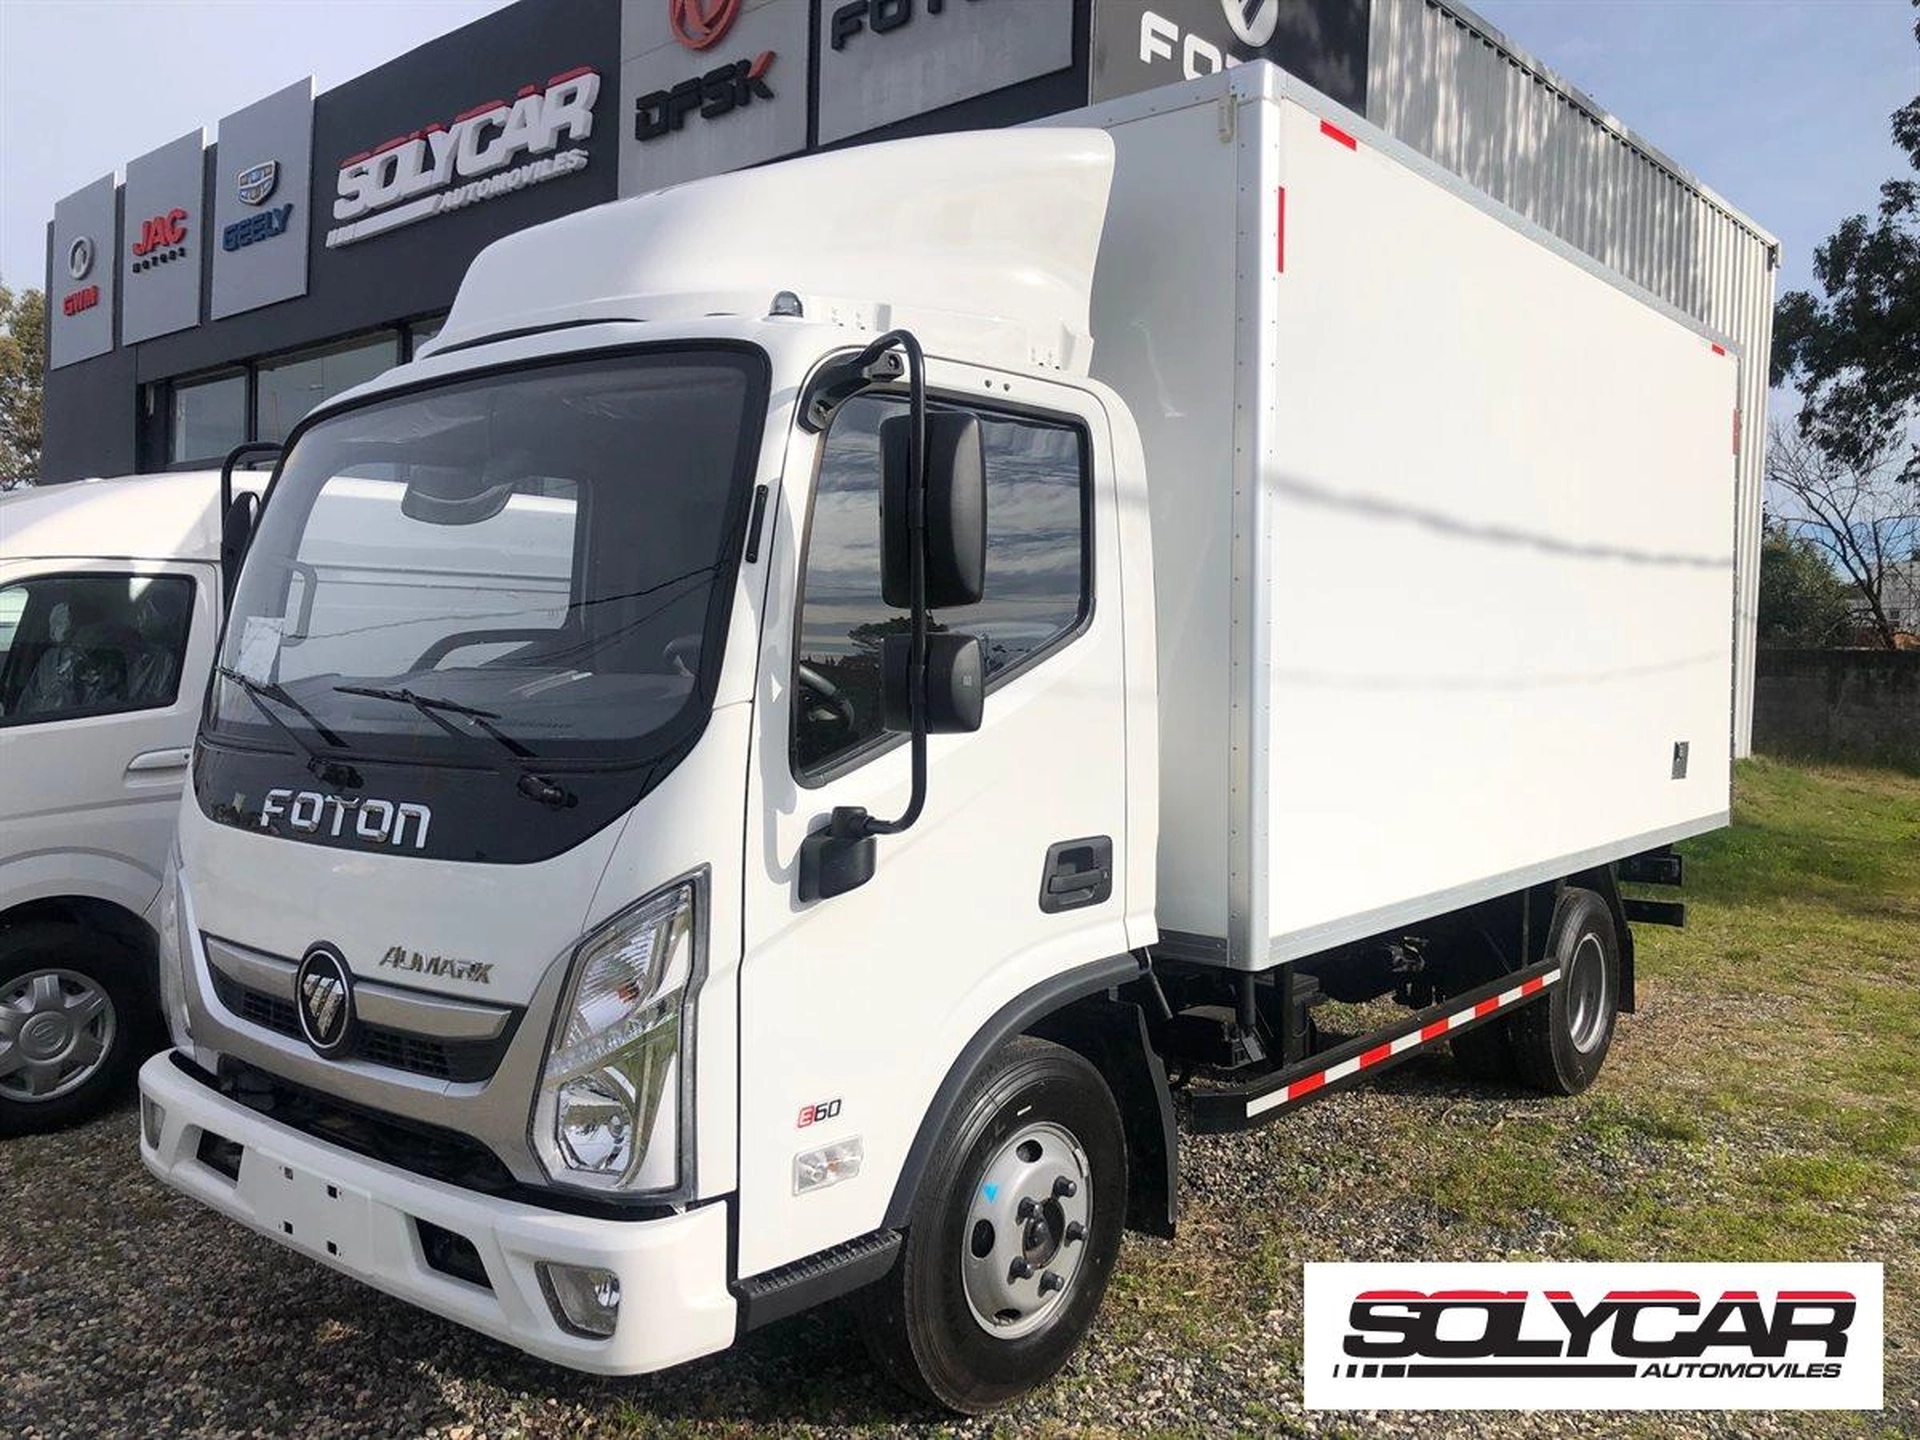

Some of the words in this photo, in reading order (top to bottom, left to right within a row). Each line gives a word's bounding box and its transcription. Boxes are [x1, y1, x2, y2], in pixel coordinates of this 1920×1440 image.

[635, 50, 776, 141] DFSK
[333, 65, 600, 219] SOLYCAR
[440, 148, 589, 212] AUTOMOVILES
[133, 208, 187, 256] JAC
[222, 203, 294, 252] GEELY
[63, 285, 99, 317] GWM
[260, 788, 432, 848] FOTON
[379, 946, 494, 984] AUMARK
[797, 1098, 842, 1128] E60
